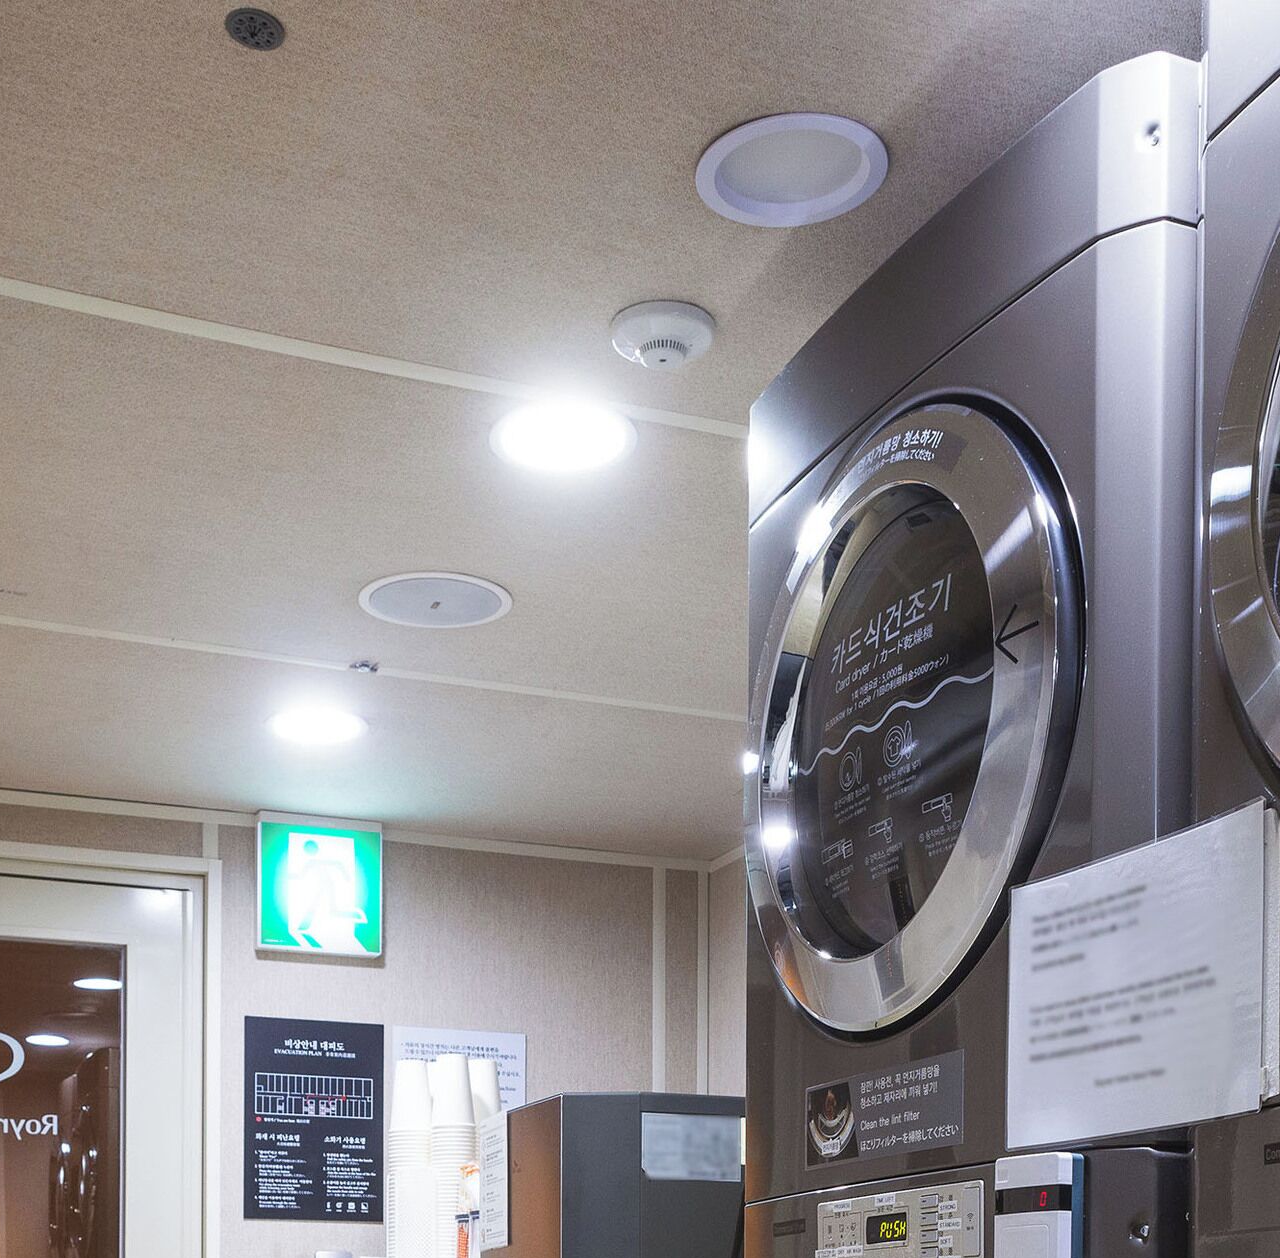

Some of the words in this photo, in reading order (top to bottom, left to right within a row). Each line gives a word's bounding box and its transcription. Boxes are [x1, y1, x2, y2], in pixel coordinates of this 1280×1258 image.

[902, 428, 944, 449] 청소하기!
[830, 572, 952, 674] 카드식건조기
[835, 672, 851, 694] Card
[851, 661, 871, 684] dryer
[274, 1048, 308, 1057] EVACUATION
[308, 1049, 323, 1057] PLAN
[860, 1118, 878, 1132] Clean
[879, 1116, 890, 1128] the
[891, 1113, 903, 1125] lint
[903, 1110, 921, 1123] filter
[879, 1220, 908, 1239] PUSH
